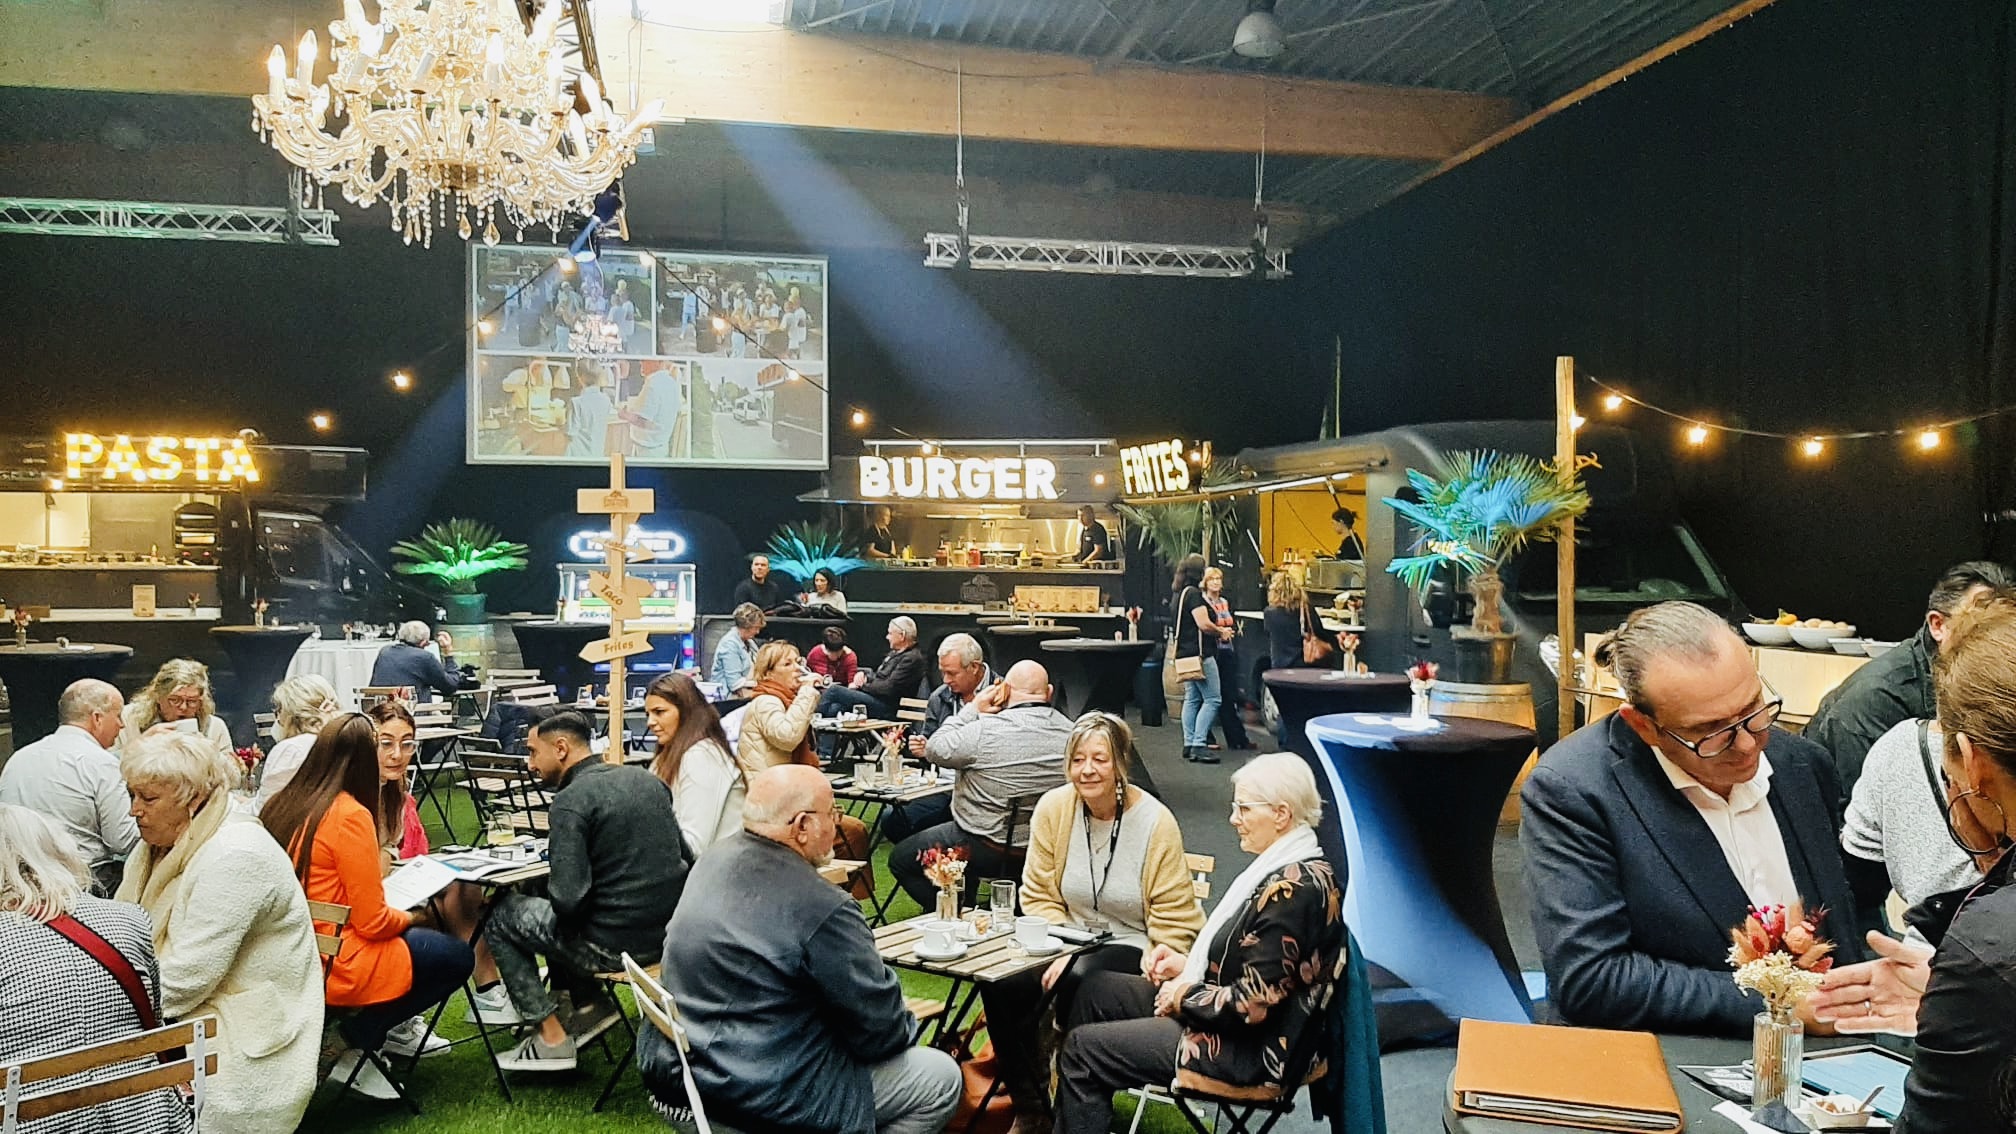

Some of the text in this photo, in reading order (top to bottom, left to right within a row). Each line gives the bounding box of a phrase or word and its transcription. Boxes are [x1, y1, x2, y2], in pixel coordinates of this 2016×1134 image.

[65, 432, 260, 482] PASTA
[859, 456, 1058, 500] BURGER
[1120, 439, 1190, 495] FRITES
[600, 584, 624, 606] Taco
[603, 640, 634, 654] Frites
